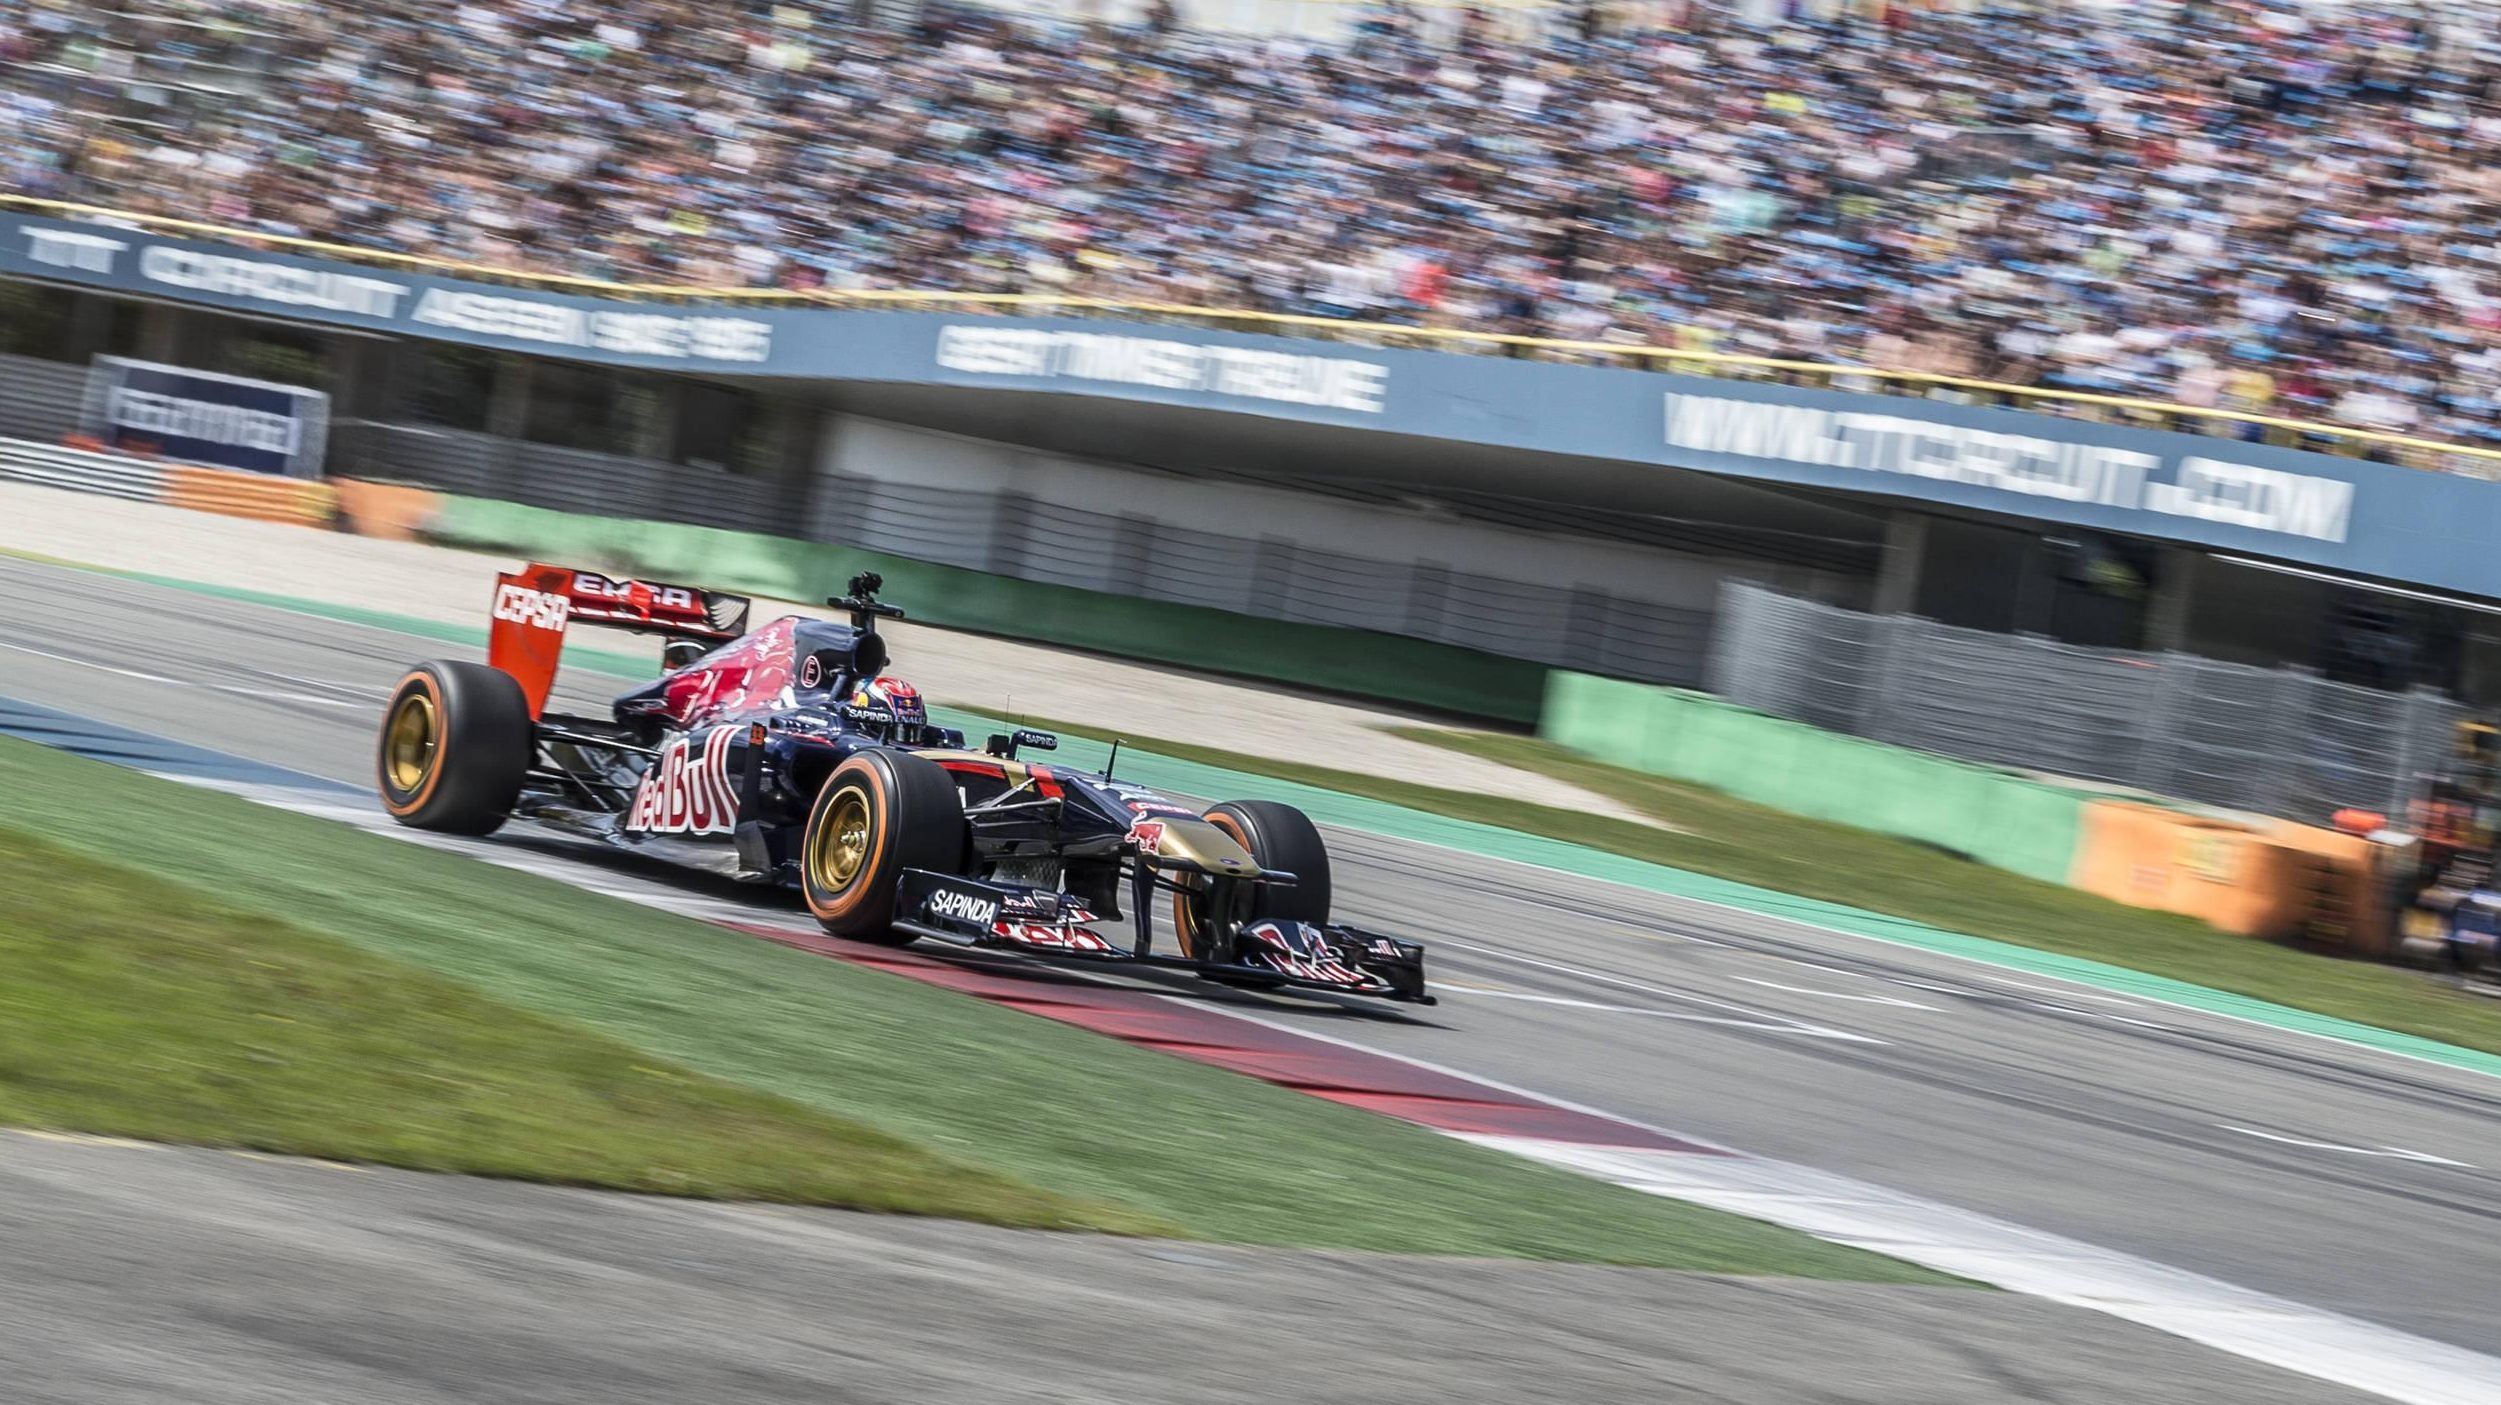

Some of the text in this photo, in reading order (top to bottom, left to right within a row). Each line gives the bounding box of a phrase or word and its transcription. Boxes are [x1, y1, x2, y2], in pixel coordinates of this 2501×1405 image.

[493, 583, 570, 632] CEPSA
[849, 709, 893, 724] SAPINDA
[930, 888, 997, 926] SAPINDA
